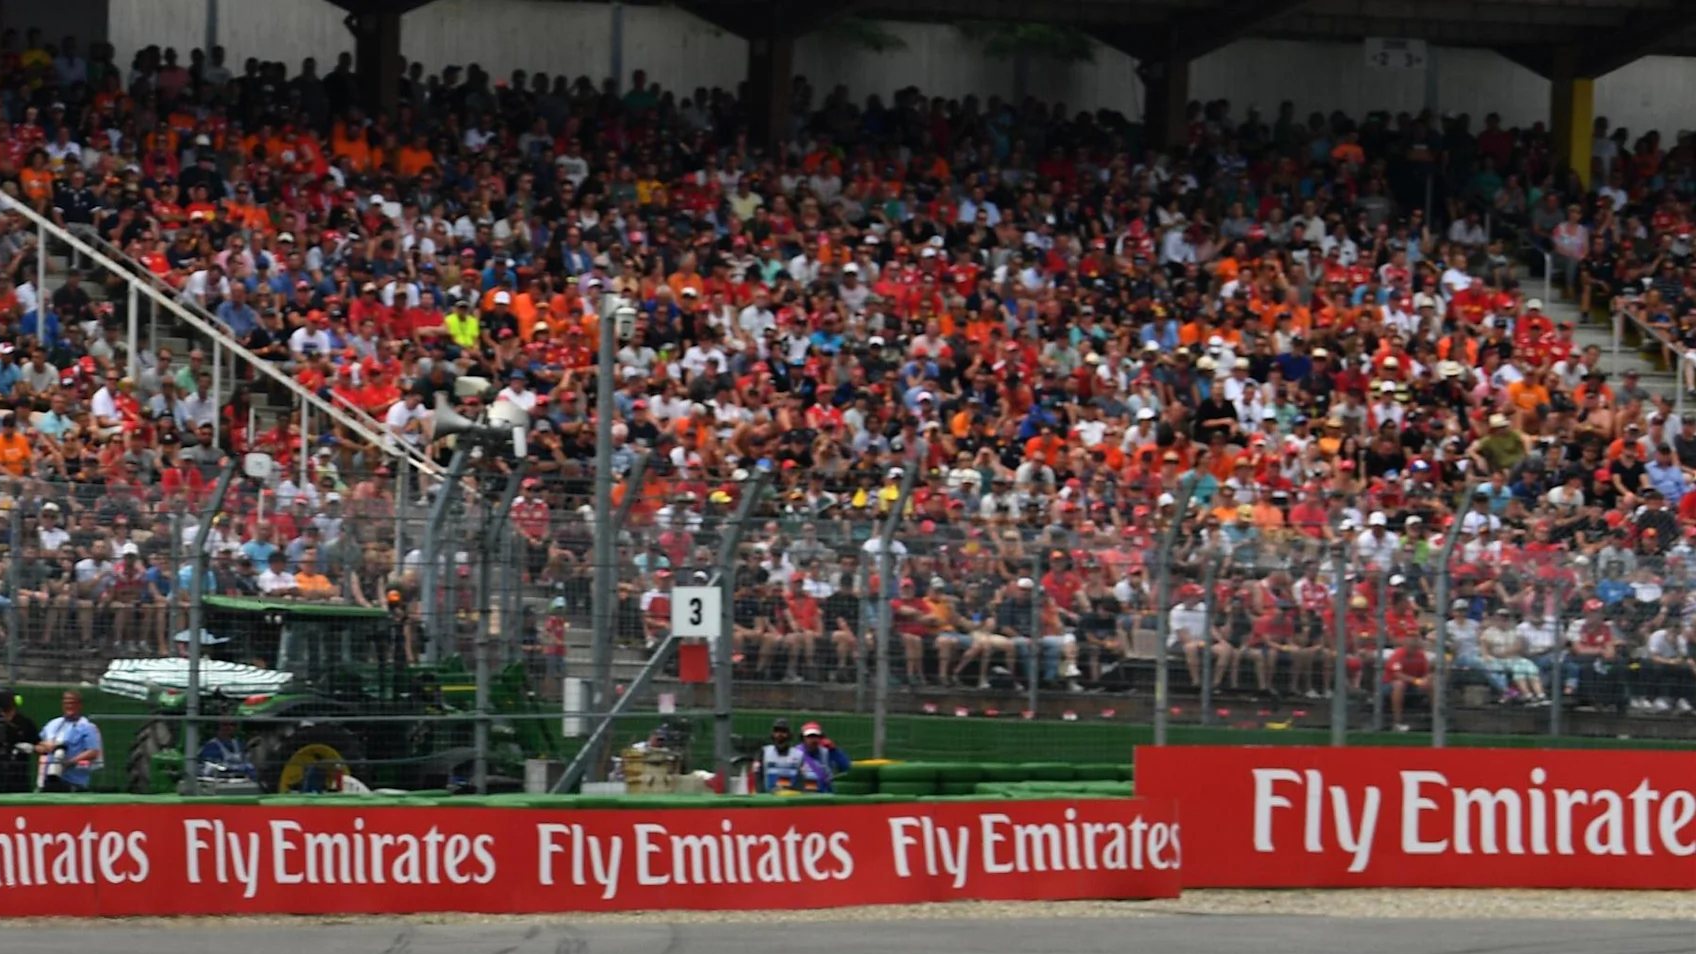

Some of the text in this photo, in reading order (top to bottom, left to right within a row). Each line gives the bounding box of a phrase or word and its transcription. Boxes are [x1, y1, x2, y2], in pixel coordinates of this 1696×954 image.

[689, 597, 702, 625] 3
[184, 817, 496, 898] Fly Emirates
[537, 819, 854, 900] Fly Emirates
[888, 807, 1181, 889] Fly Emirates
[1253, 767, 1696, 872] Fly Emirate
